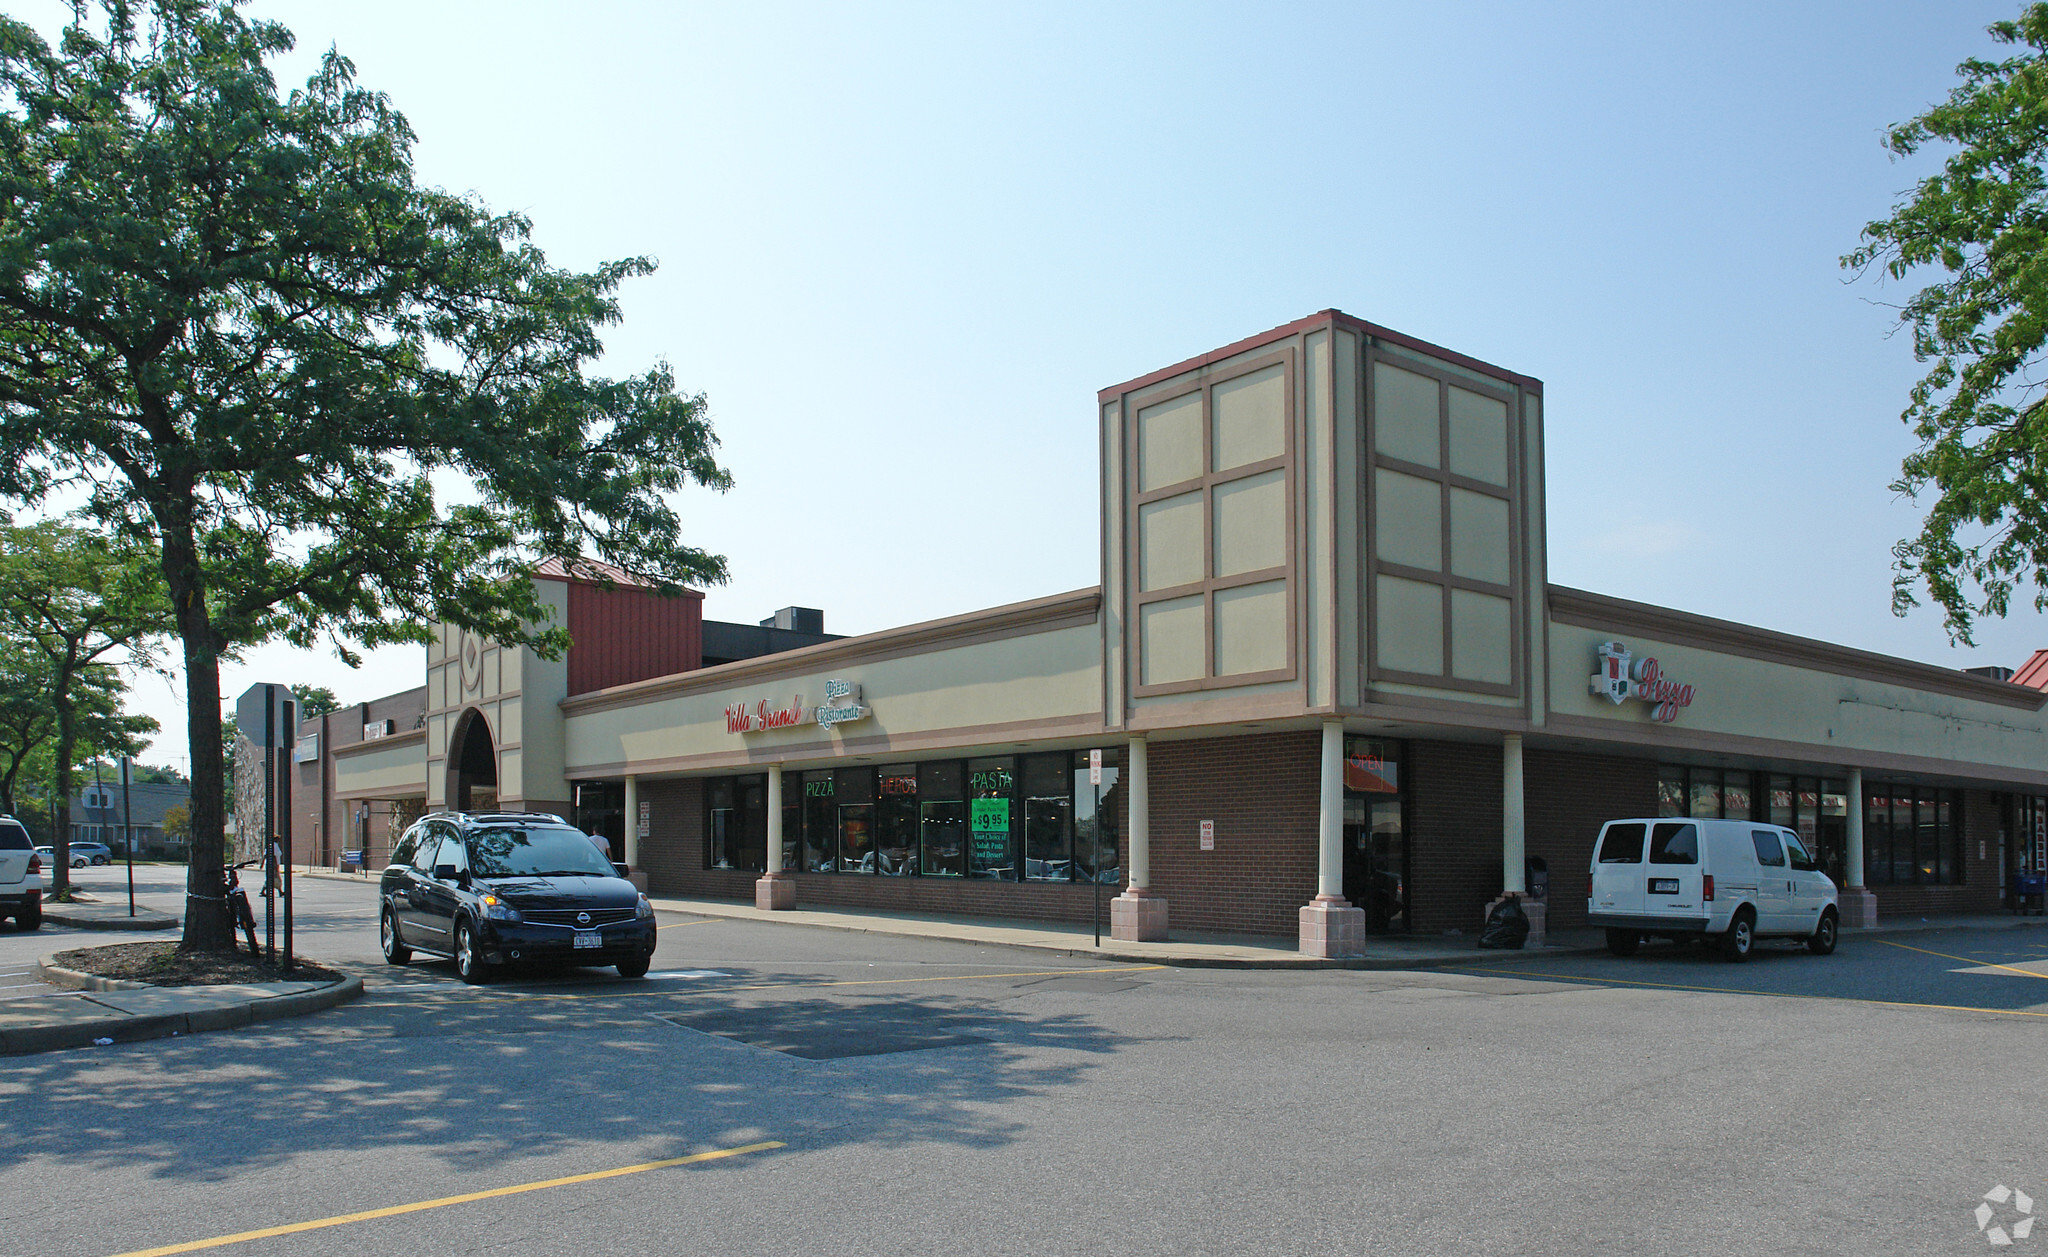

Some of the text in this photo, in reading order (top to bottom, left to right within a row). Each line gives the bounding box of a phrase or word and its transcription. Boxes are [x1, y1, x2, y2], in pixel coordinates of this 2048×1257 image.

[825, 679, 850, 698] Pizza
[1638, 656, 1696, 722] Pizza
[724, 694, 802, 735] Villa Grande
[816, 704, 860, 730] Ristorante
[1350, 753, 1383, 771] OPEN
[806, 781, 834, 797] PIZZA
[881, 777, 917, 794] HEROS
[973, 771, 1012, 789] PASTA
[978, 813, 1002, 829] $9.95
